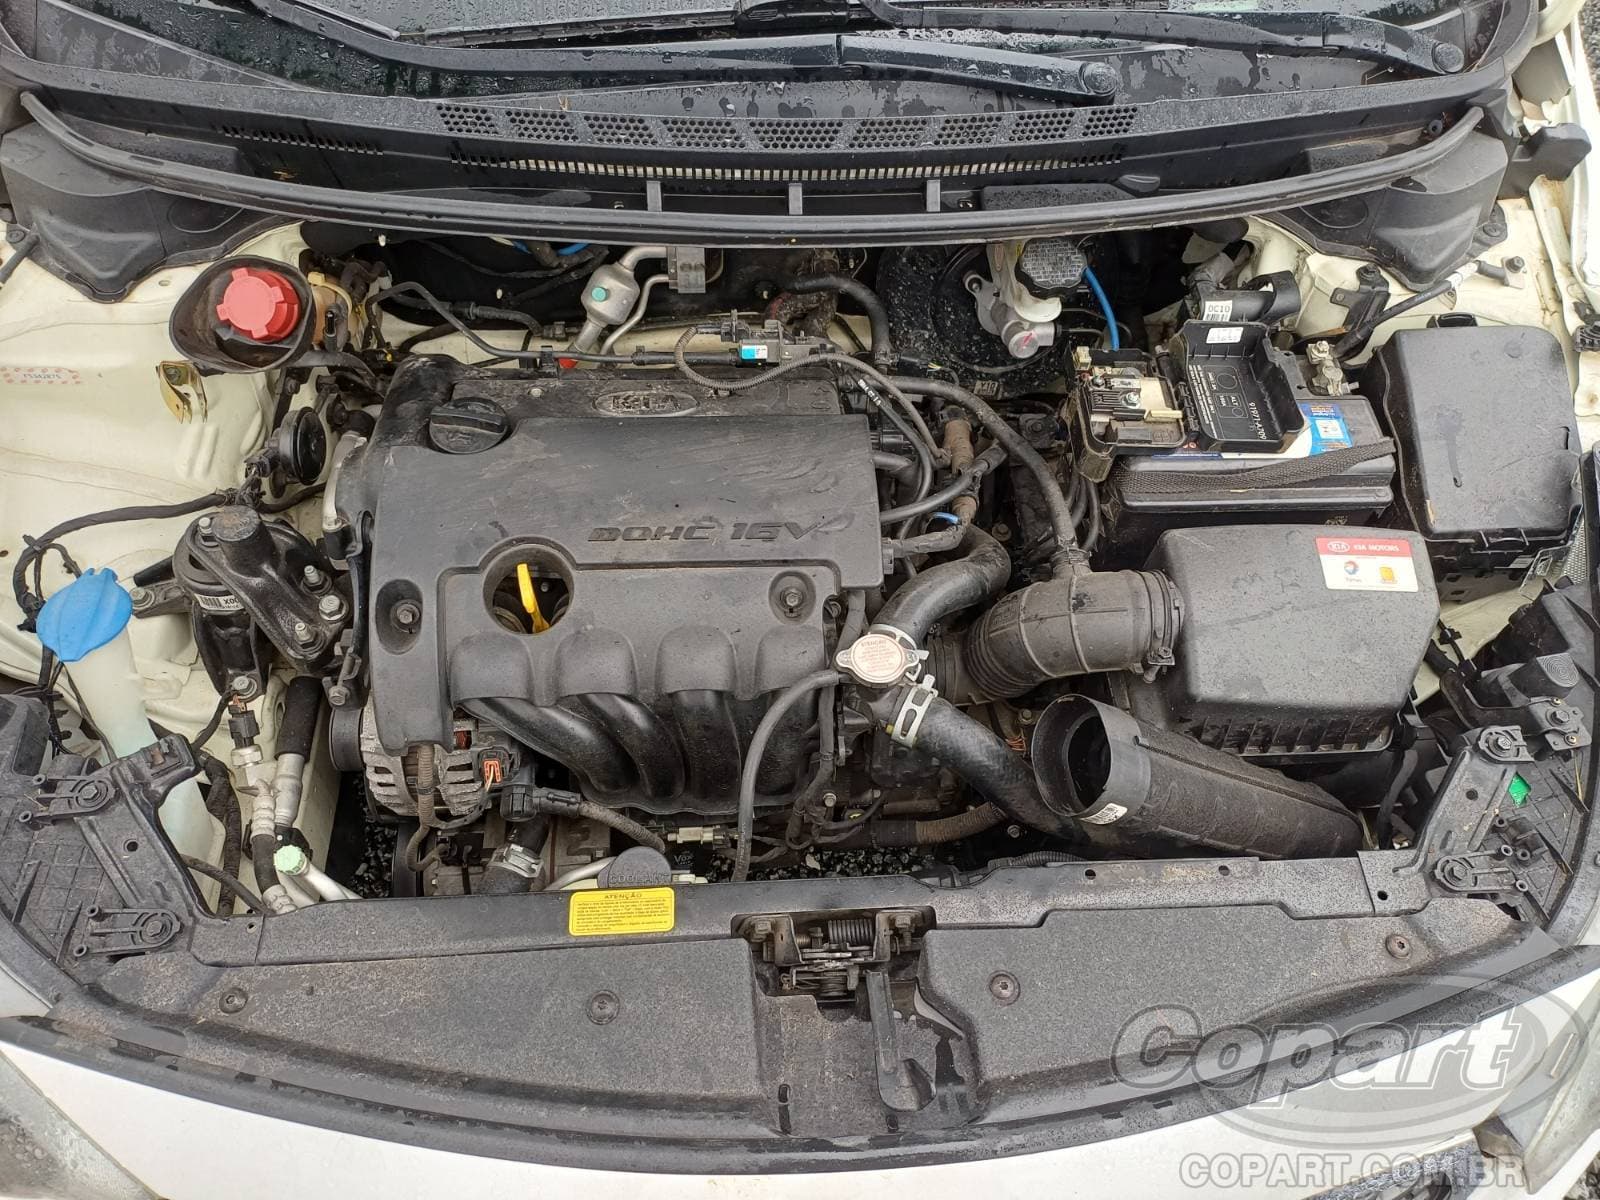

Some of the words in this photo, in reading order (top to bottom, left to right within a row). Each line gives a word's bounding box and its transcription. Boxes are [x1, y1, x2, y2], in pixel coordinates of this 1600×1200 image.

[587, 525, 716, 542] DOHC
[730, 522, 824, 541] 16V
[603, 892, 643, 900] ATENÇÃO
